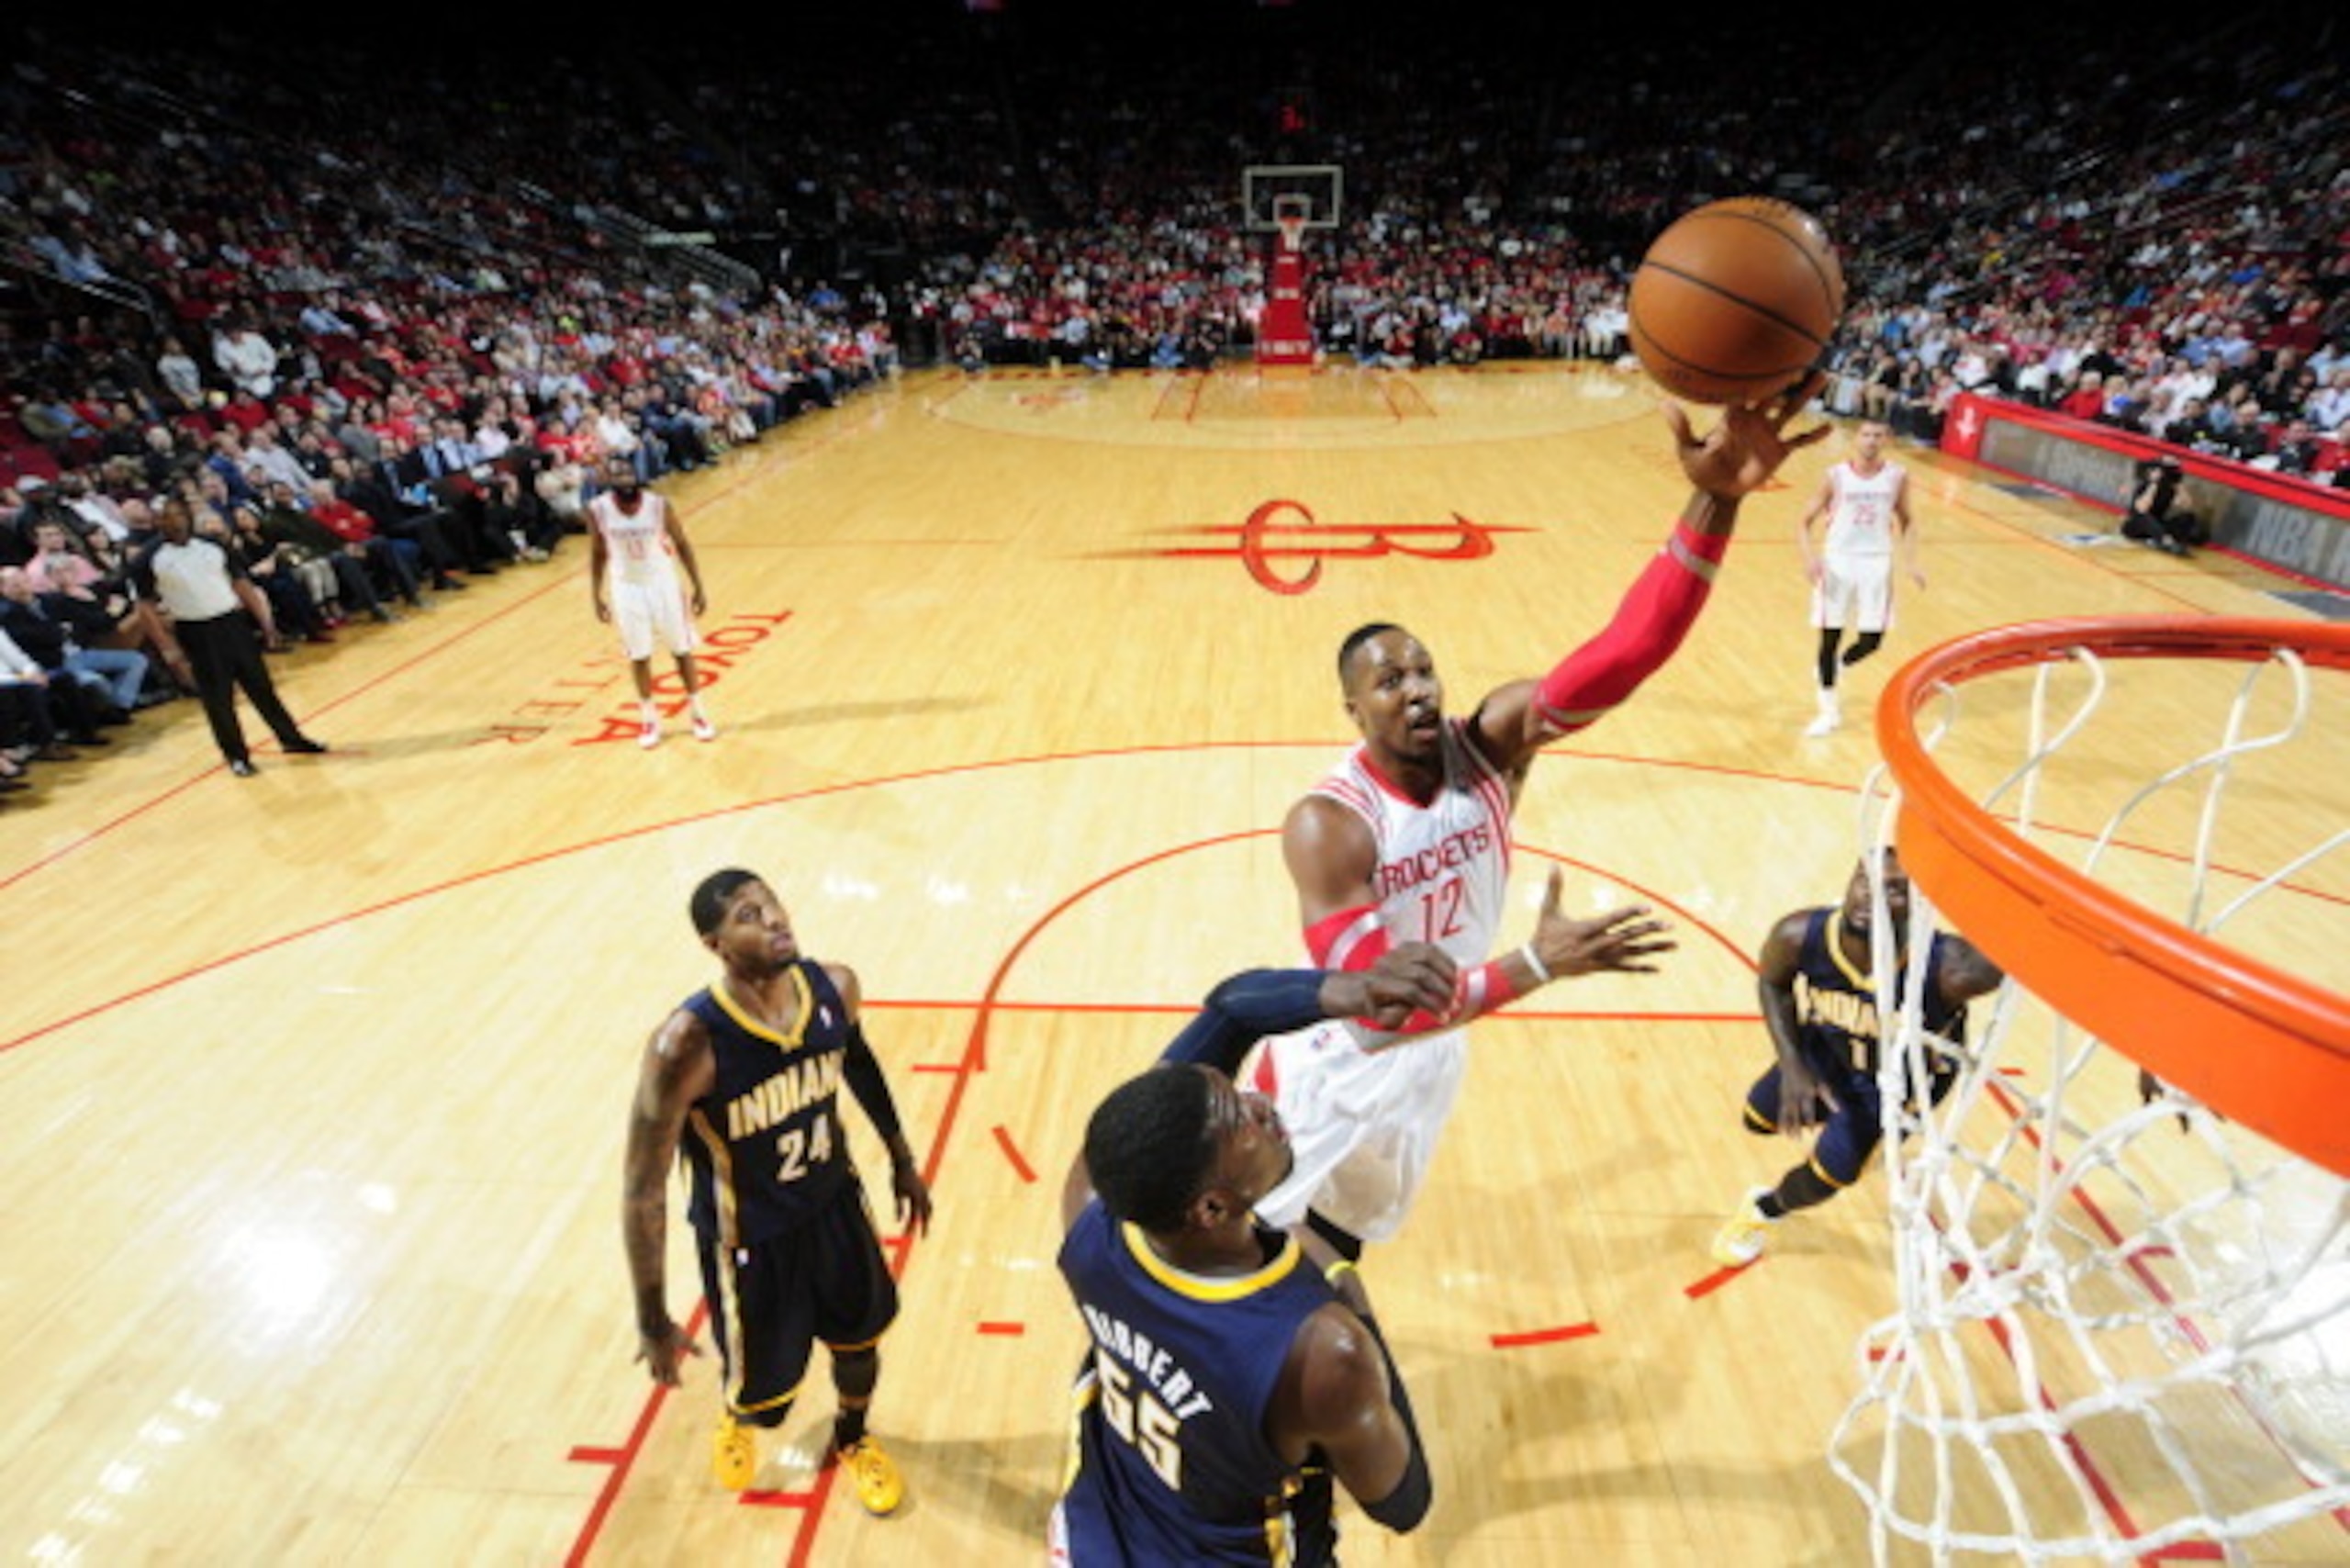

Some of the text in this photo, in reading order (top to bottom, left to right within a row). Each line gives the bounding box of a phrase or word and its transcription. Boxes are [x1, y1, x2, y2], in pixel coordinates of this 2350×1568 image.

[2245, 499, 2329, 571] NBA
[1421, 875, 1463, 943] 12
[728, 1049, 845, 1141] INDIAN
[776, 1114, 833, 1182] 24
[1097, 1346, 1181, 1492] 55
